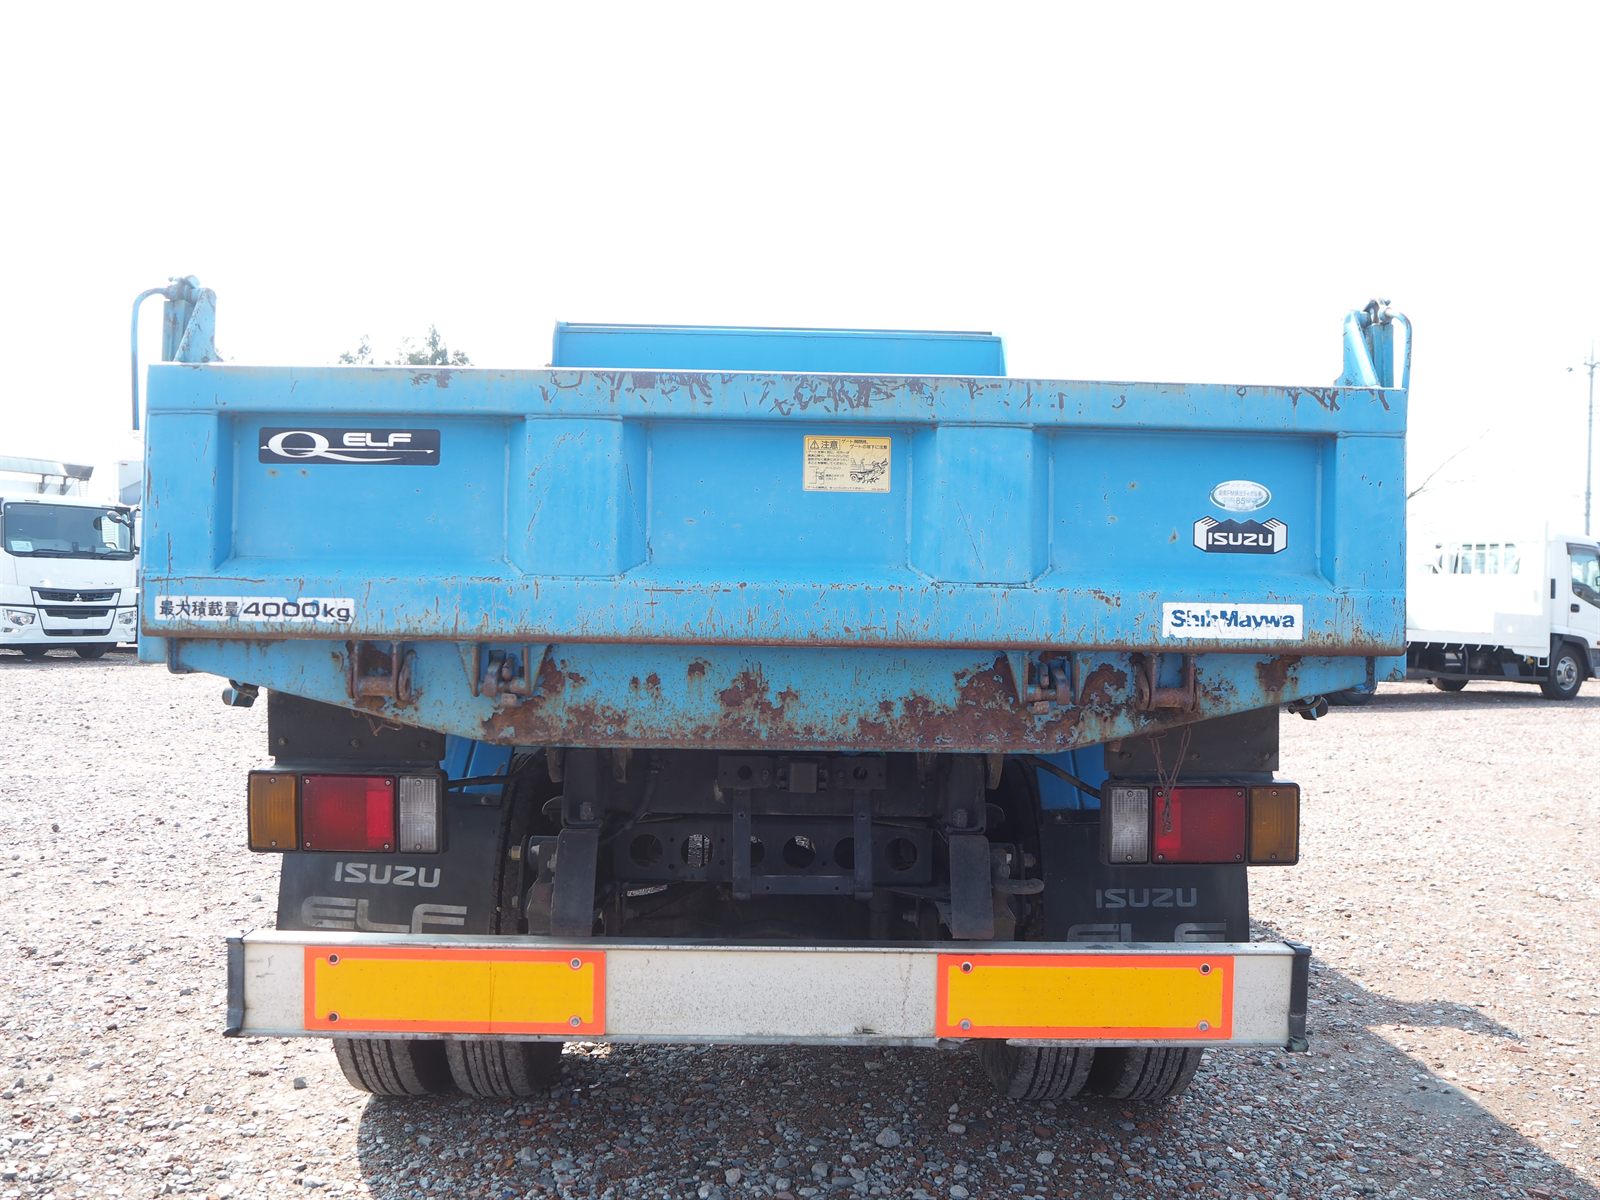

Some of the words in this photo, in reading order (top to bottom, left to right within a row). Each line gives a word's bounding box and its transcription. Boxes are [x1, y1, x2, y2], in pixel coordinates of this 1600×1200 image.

[342, 432, 412, 447] ELF
[820, 440, 838, 450] 注意
[1207, 532, 1273, 547] ISUZU
[159, 600, 240, 617] 最大積載量
[243, 602, 350, 621] 4000kg
[334, 862, 441, 888] ISUZU
[1095, 887, 1197, 909] ISUZU
[301, 895, 467, 934] ELF
